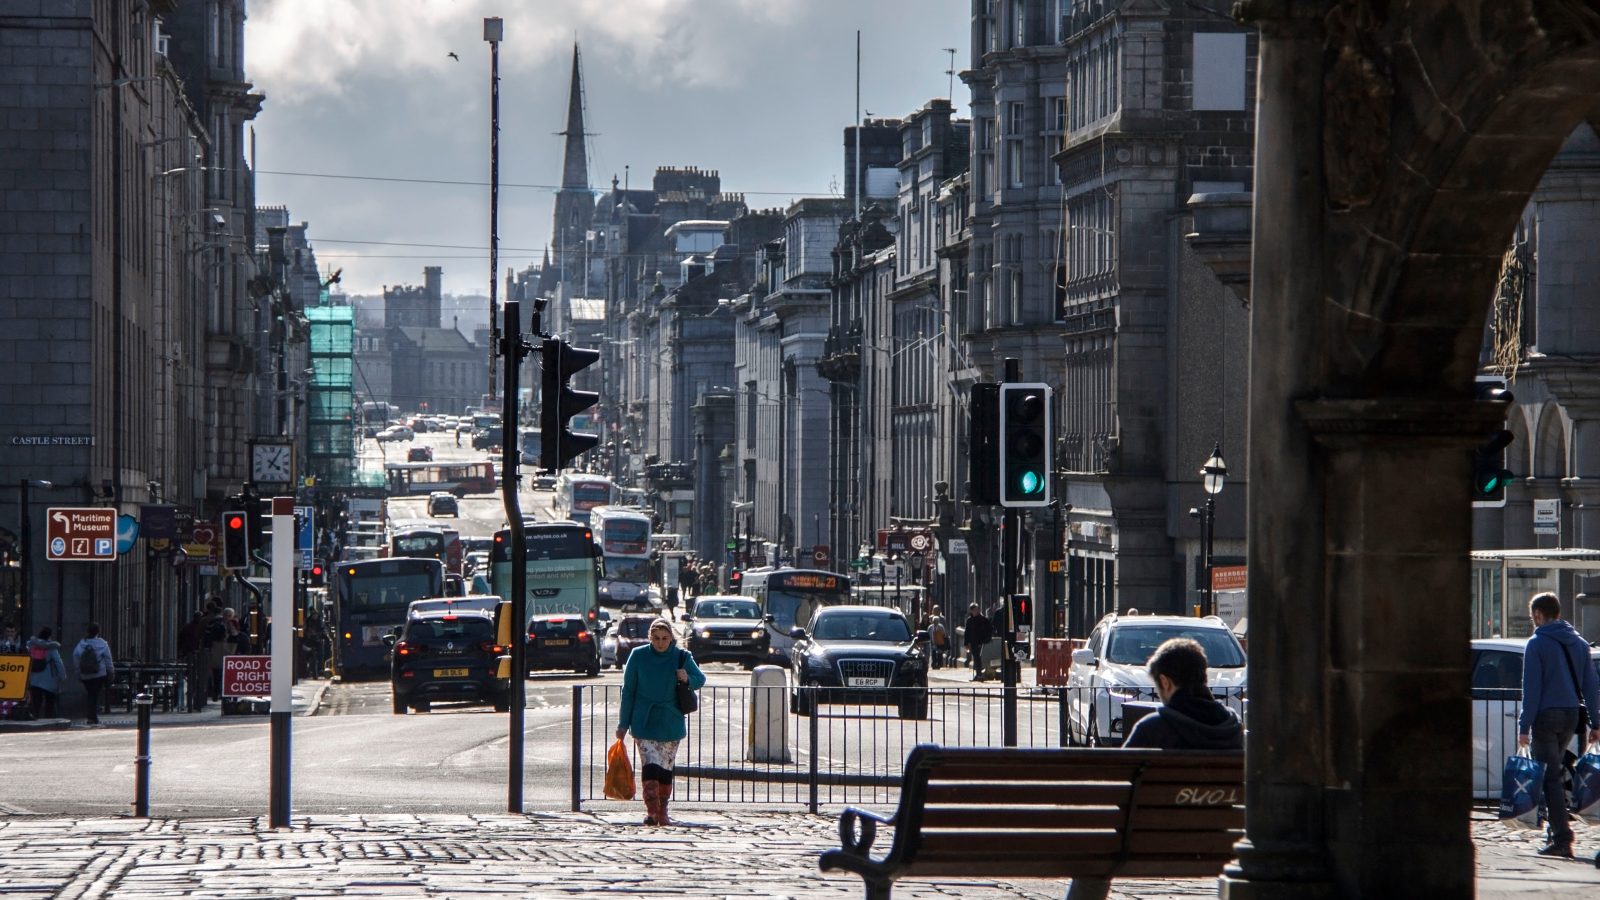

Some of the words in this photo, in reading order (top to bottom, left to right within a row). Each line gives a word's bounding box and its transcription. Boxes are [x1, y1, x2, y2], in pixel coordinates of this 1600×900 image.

[12, 436, 50, 445] CASTLE
[52, 436, 90, 445] STREET
[72, 513, 111, 522] Maritime
[73, 523, 110, 531] Museum
[99, 540, 110, 553] P
[826, 576, 836, 588] 23
[0, 662, 25, 673] sion
[227, 660, 261, 670] ROAD
[237, 671, 272, 681] RIGHT
[231, 682, 272, 692] CLOSE
